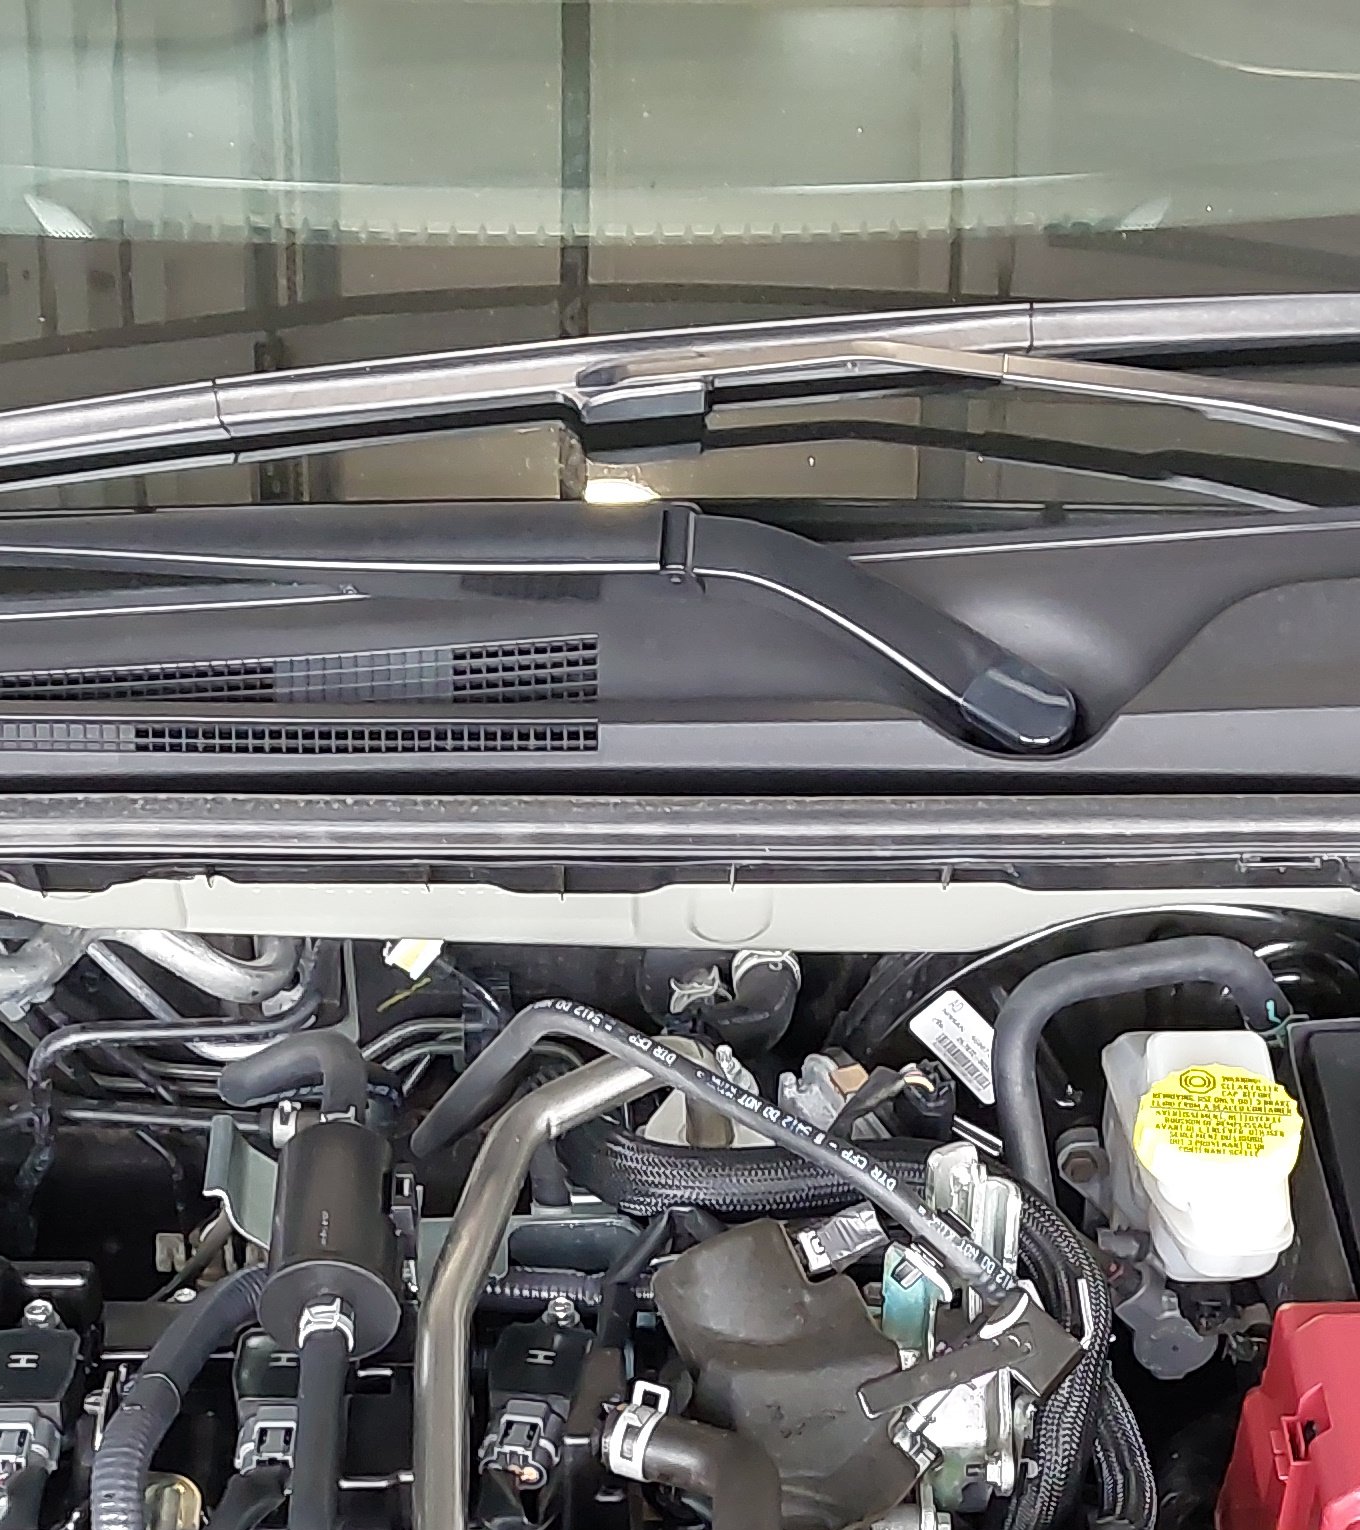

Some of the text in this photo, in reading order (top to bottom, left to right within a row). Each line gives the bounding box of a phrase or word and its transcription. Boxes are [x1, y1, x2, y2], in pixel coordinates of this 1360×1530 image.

[737, 1095, 763, 1113] NOT
[841, 1150, 868, 1171] CFP
[871, 1165, 897, 1191] DTR
